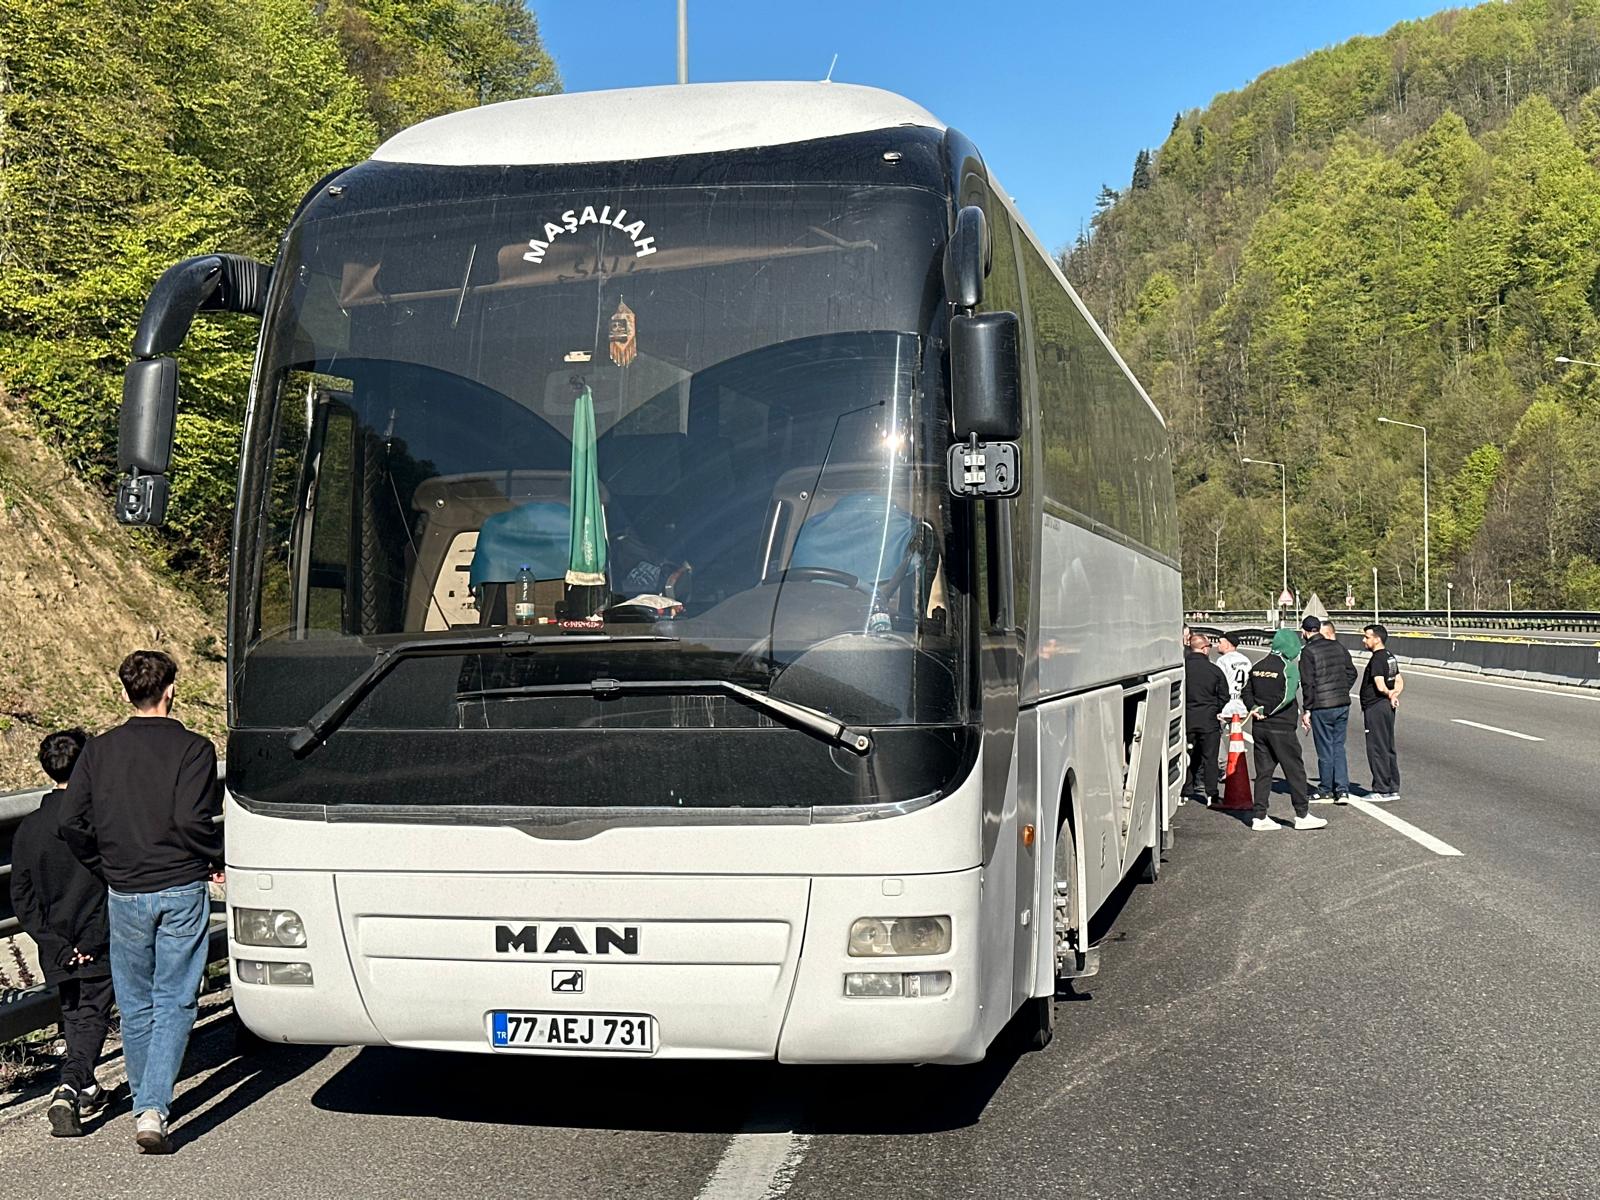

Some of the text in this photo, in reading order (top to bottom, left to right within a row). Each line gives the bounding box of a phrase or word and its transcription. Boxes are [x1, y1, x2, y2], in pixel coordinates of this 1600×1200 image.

[522, 205, 657, 264] MAŞALLAH
[495, 925, 638, 955] MAN
[496, 1016, 646, 1046] TR 77 AEJ 731
